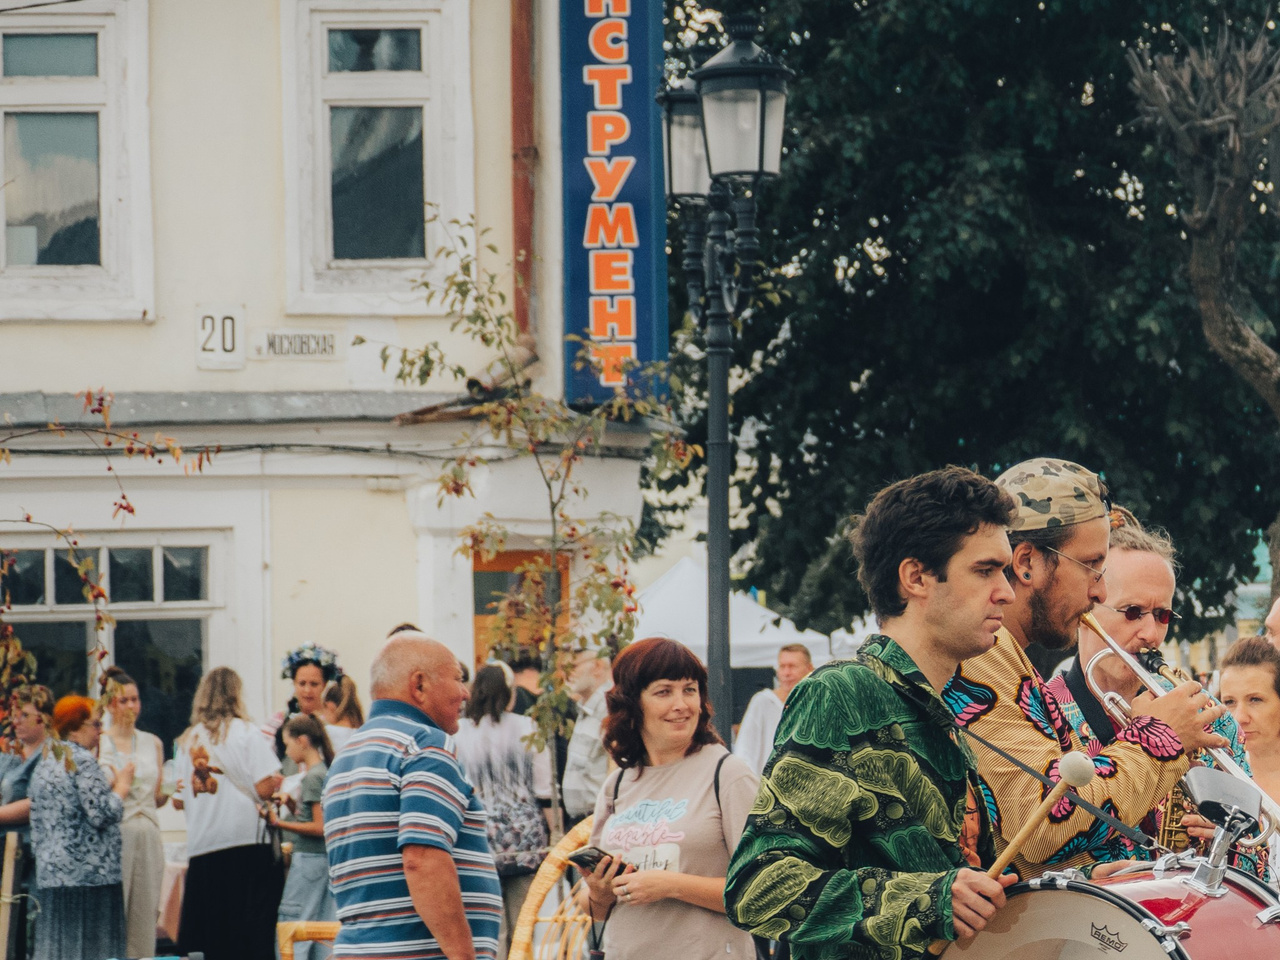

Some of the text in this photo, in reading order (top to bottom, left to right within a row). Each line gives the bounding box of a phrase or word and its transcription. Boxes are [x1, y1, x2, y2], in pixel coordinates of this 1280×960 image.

[201, 314, 236, 353] 20
[267, 333, 335, 355] МОСКОВСКАЯ
[1093, 930, 1122, 949] REMO
